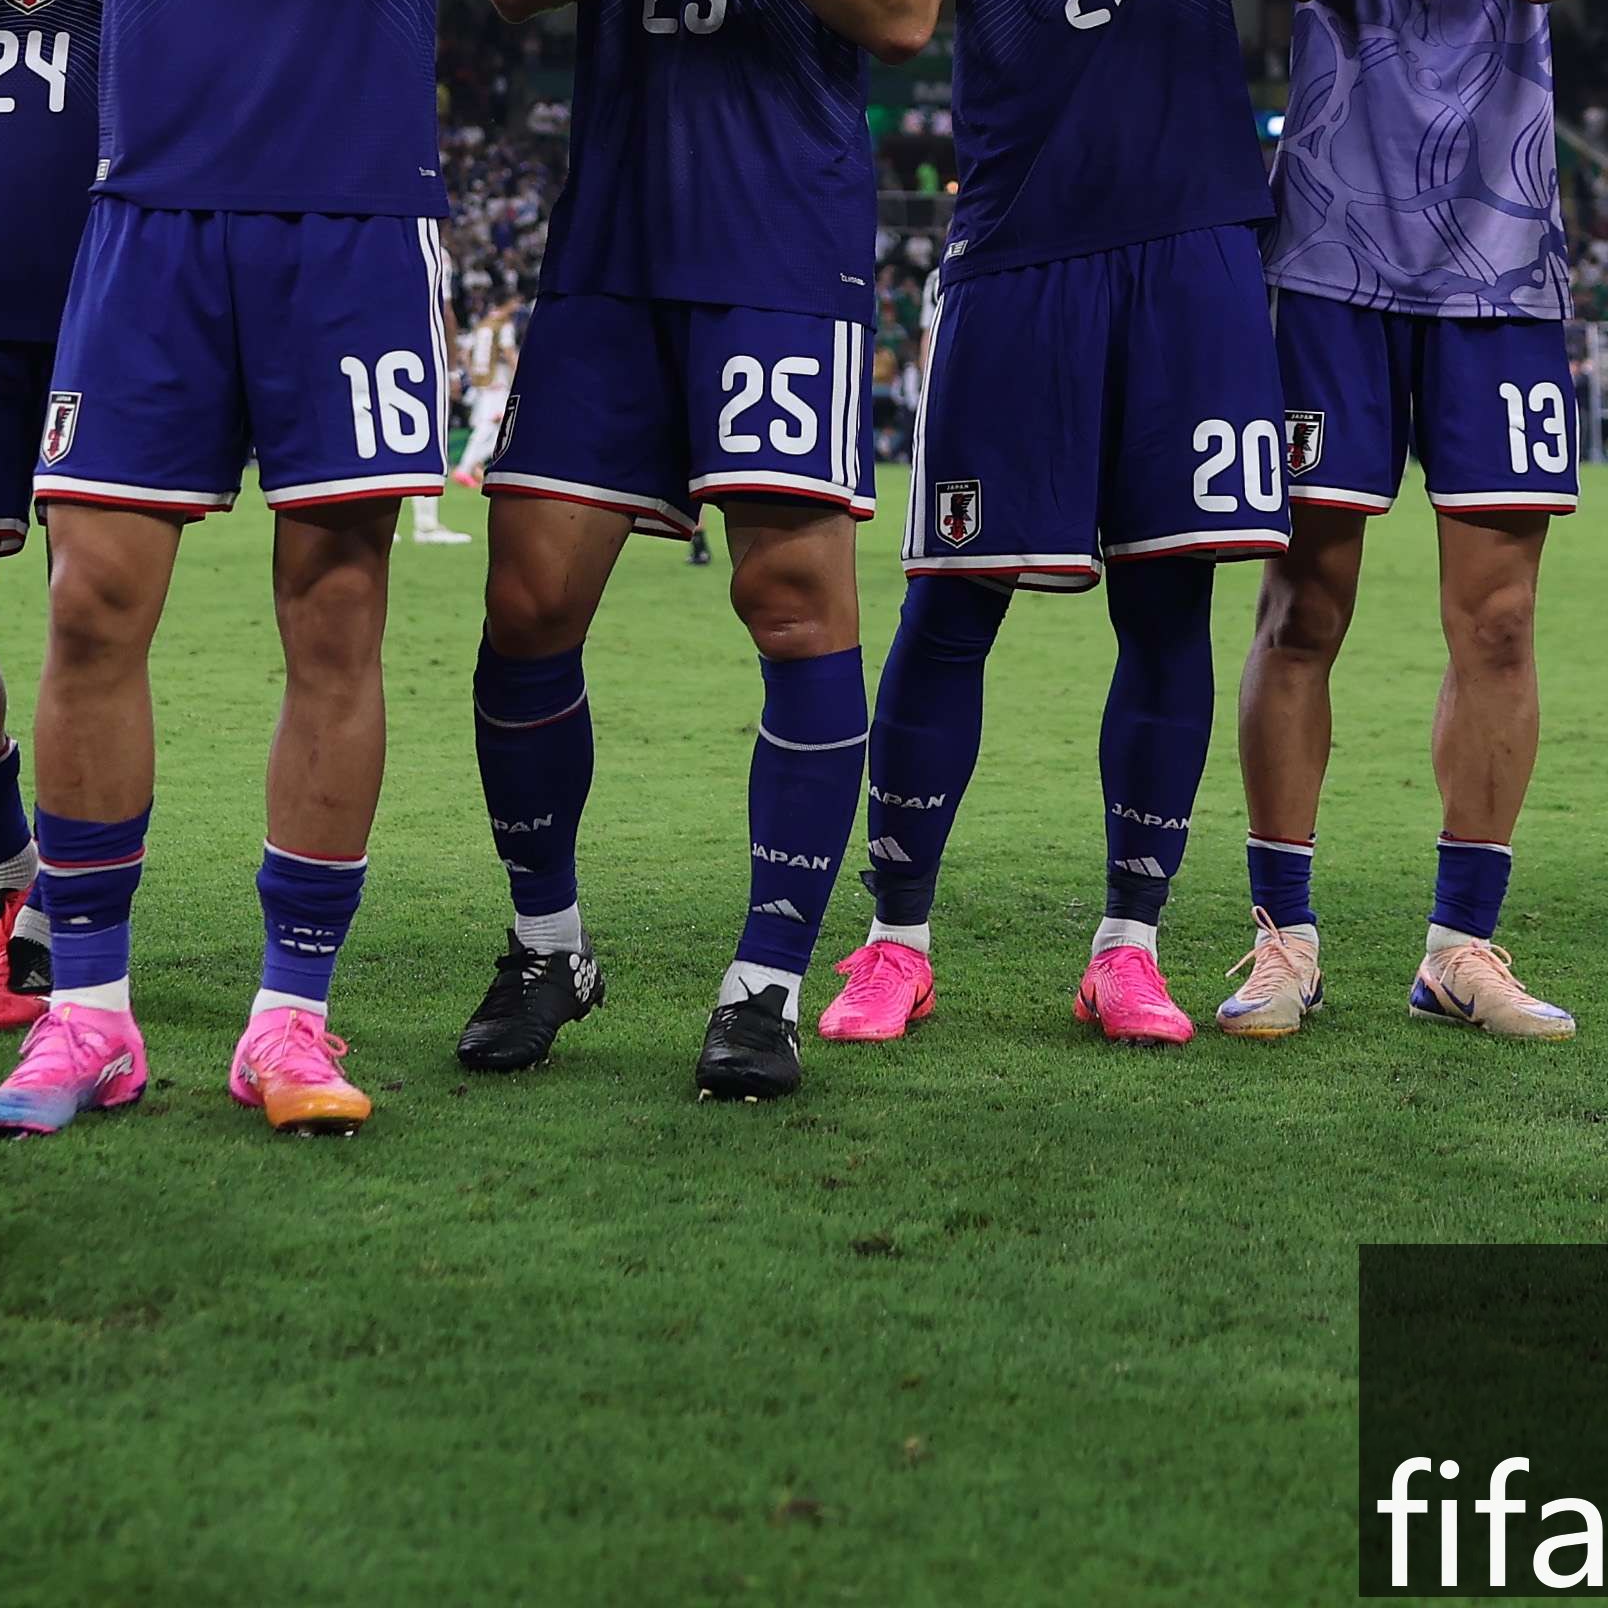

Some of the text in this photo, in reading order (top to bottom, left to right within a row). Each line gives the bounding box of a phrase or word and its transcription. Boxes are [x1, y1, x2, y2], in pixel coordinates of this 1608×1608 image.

[340, 350, 431, 459] 16
[718, 355, 820, 455] 25
[1499, 381, 1569, 474] 13
[946, 483, 970, 491] JAPAN
[1192, 419, 1283, 513] 20
[493, 813, 553, 834] PAN
[869, 785, 946, 810] APAN
